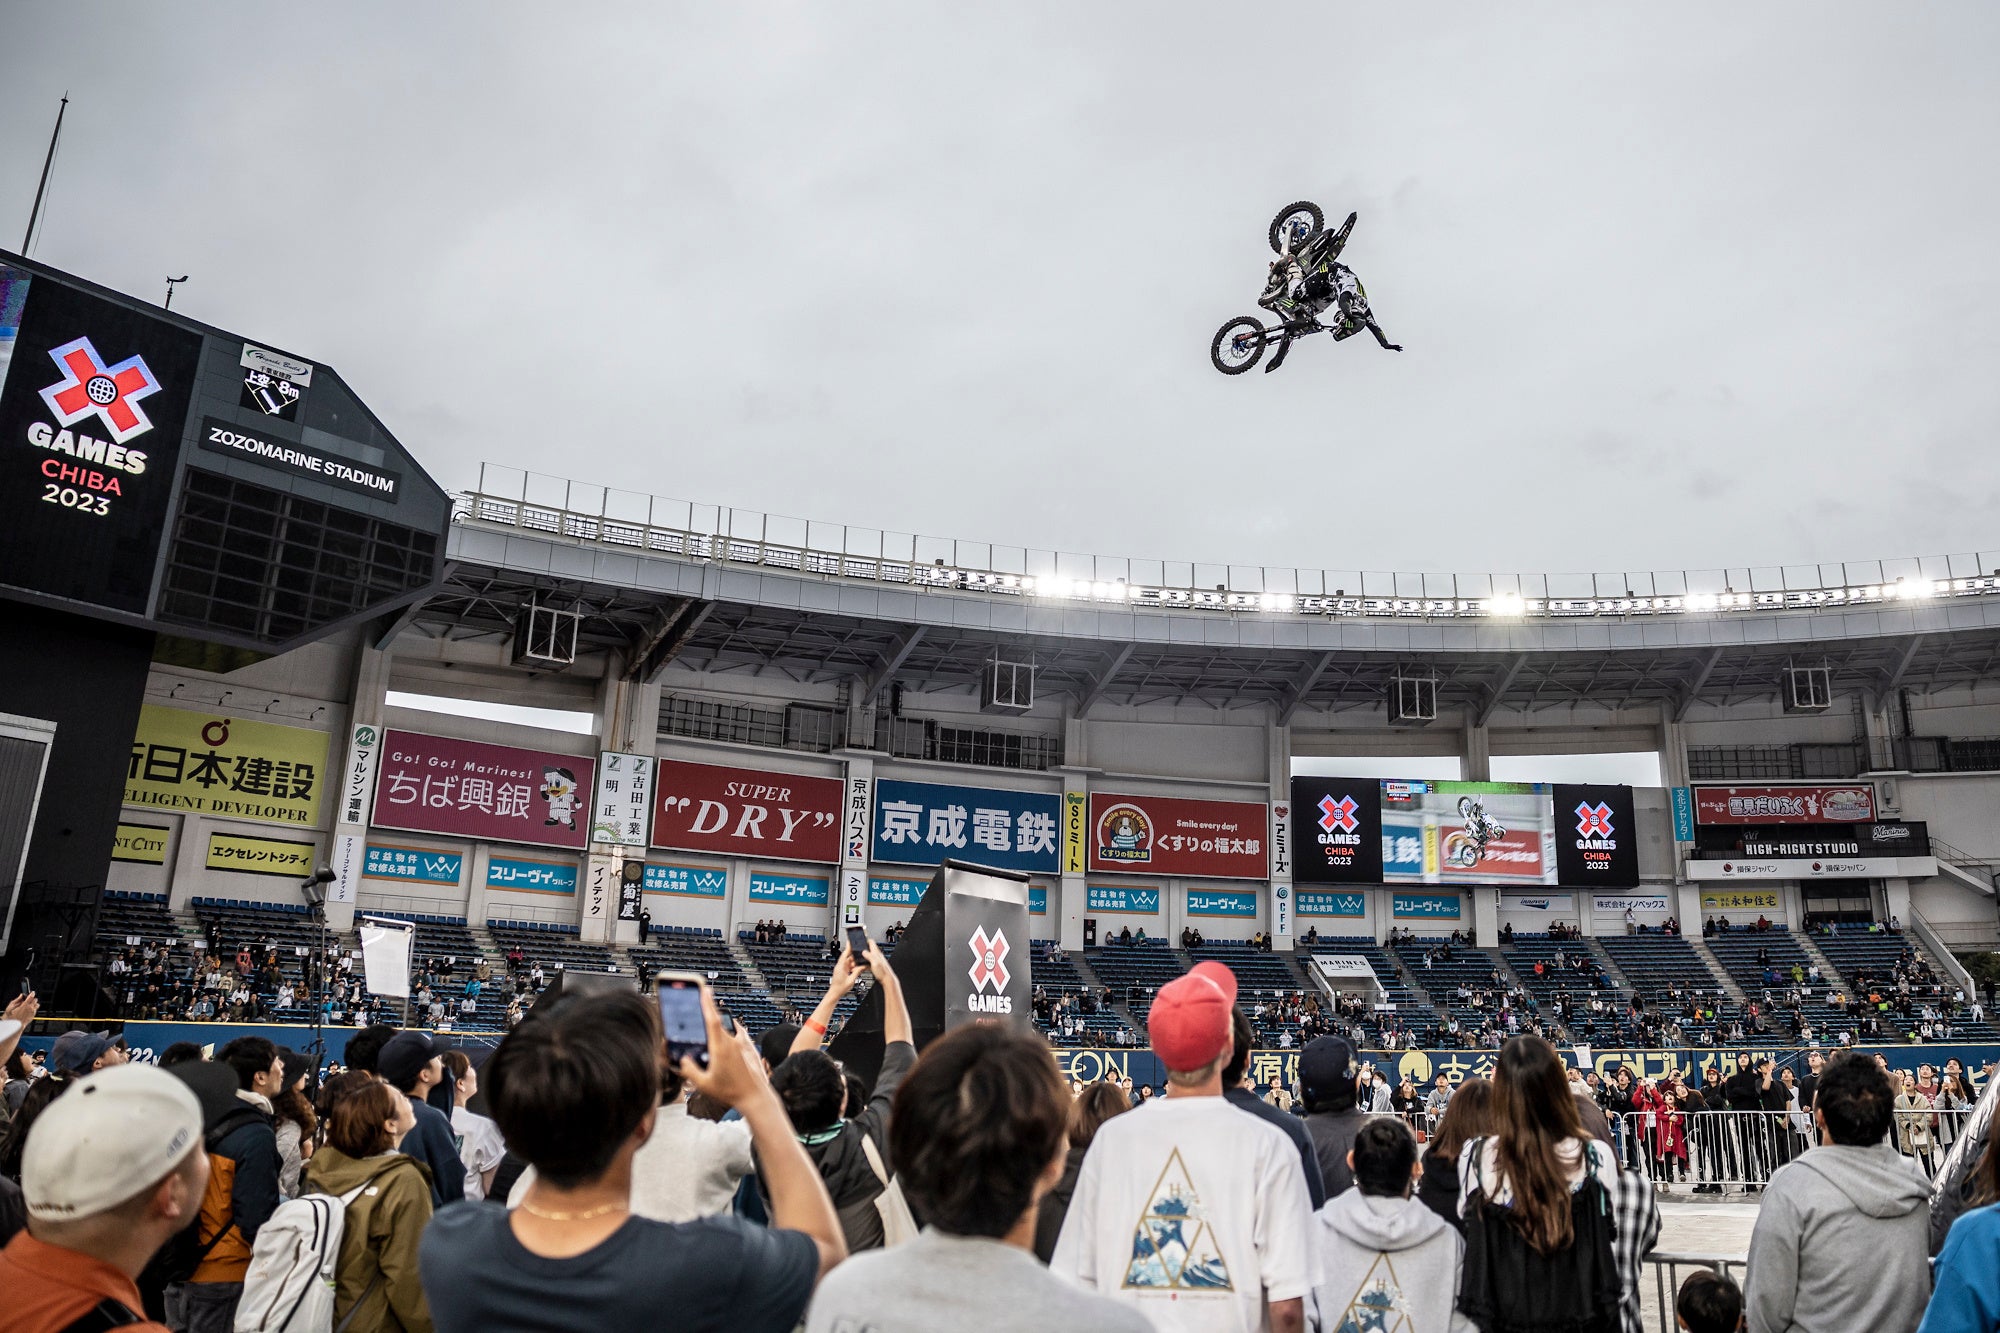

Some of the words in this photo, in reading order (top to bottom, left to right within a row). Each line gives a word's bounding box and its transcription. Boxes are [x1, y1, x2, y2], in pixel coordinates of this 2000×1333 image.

[244, 370, 270, 388] 上空
[27, 421, 148, 475] GAMES
[209, 427, 322, 473] ZOZOMARINE
[323, 461, 394, 493] STADIUM
[41, 459, 122, 496] CHIBA
[42, 484, 111, 516] 2023
[392, 752, 419, 764] Go!
[428, 757, 456, 769] Go!
[463, 761, 532, 780] Marines!
[347, 750, 369, 822] マルシン運輸
[388, 770, 532, 819] ちば興銀
[724, 782, 791, 802] SUPER
[211, 800, 308, 821] DEVELOPER
[628, 776, 645, 836] 吉田工業
[850, 779, 867, 840] 京成バス
[1677, 789, 1688, 839] 文化シャッター
[1730, 797, 1803, 815] 雪見だいふく
[880, 800, 1056, 854] 京成電鉄
[1176, 819, 1198, 828] Smile
[1199, 823, 1221, 831] every
[1221, 823, 1238, 832] day!
[1873, 826, 1909, 840] Marines
[1070, 805, 1079, 871] SCミート
[1157, 834, 1260, 855] くすりの福太郎
[1275, 823, 1289, 872] アミューズ
[1317, 833, 1360, 845] GAMES
[1576, 839, 1617, 850] GAMES
[212, 846, 309, 865] エクセレントシティ
[369, 851, 418, 864] 収益物件
[1101, 849, 1148, 858] くすりの福太郎
[1325, 847, 1355, 856] CHIBA
[1327, 857, 1352, 865] 2023
[1583, 852, 1611, 860] CHIBA
[368, 862, 417, 875] 改修&売買
[646, 868, 688, 879] 収益物件
[1586, 861, 1609, 869] 2023
[1737, 865, 1778, 873] 損保ジャパン
[1825, 864, 1867, 872] 損保ジャパン
[591, 867, 604, 914] イノテック
[646, 879, 687, 890] 改修&売買
[848, 876, 860, 900] coly
[619, 883, 636, 917] 菊屋
[1731, 895, 1777, 906] 永和住宅
[968, 993, 1012, 1013] GAMES
